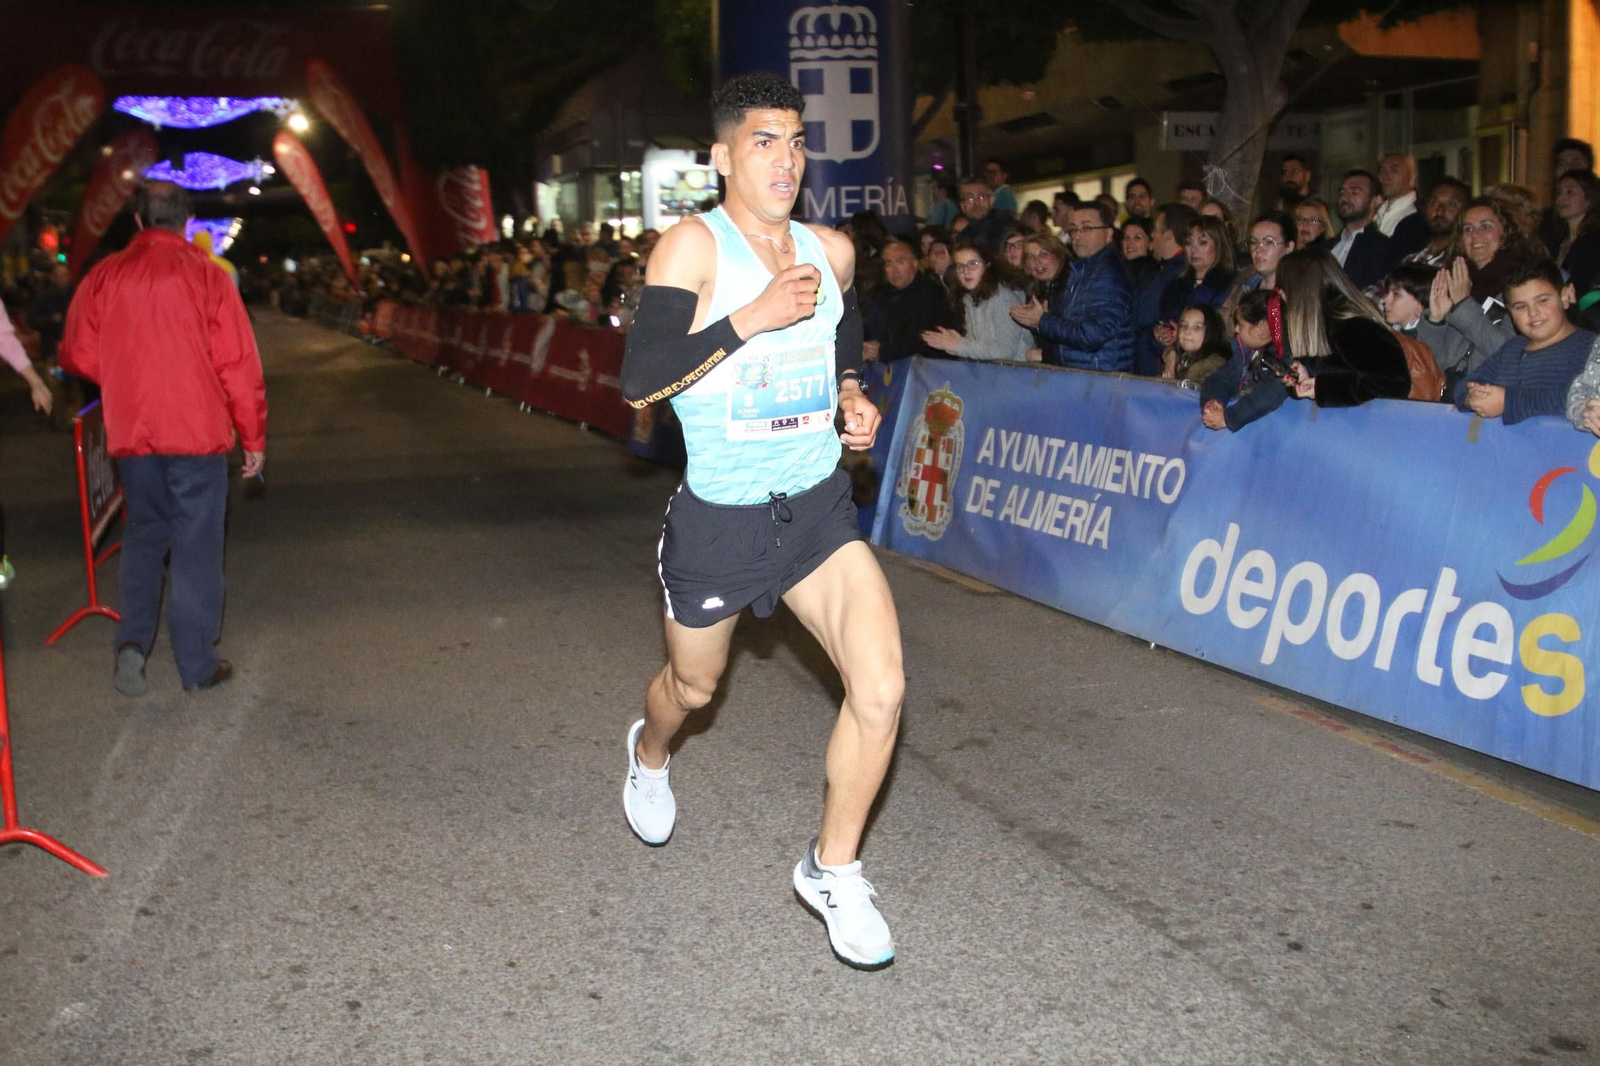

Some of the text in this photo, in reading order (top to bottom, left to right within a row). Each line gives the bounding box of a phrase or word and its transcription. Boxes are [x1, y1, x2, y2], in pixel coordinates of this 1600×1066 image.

[803, 176, 909, 219] MERÍA
[645, 386, 675, 403] YOUR
[671, 347, 727, 392] EXPECTATION
[774, 374, 826, 404] 2577
[976, 427, 1187, 505] AYUNTAMIENTO
[965, 476, 1113, 550] DE ALMERÍA
[1180, 522, 1586, 717] deportes
